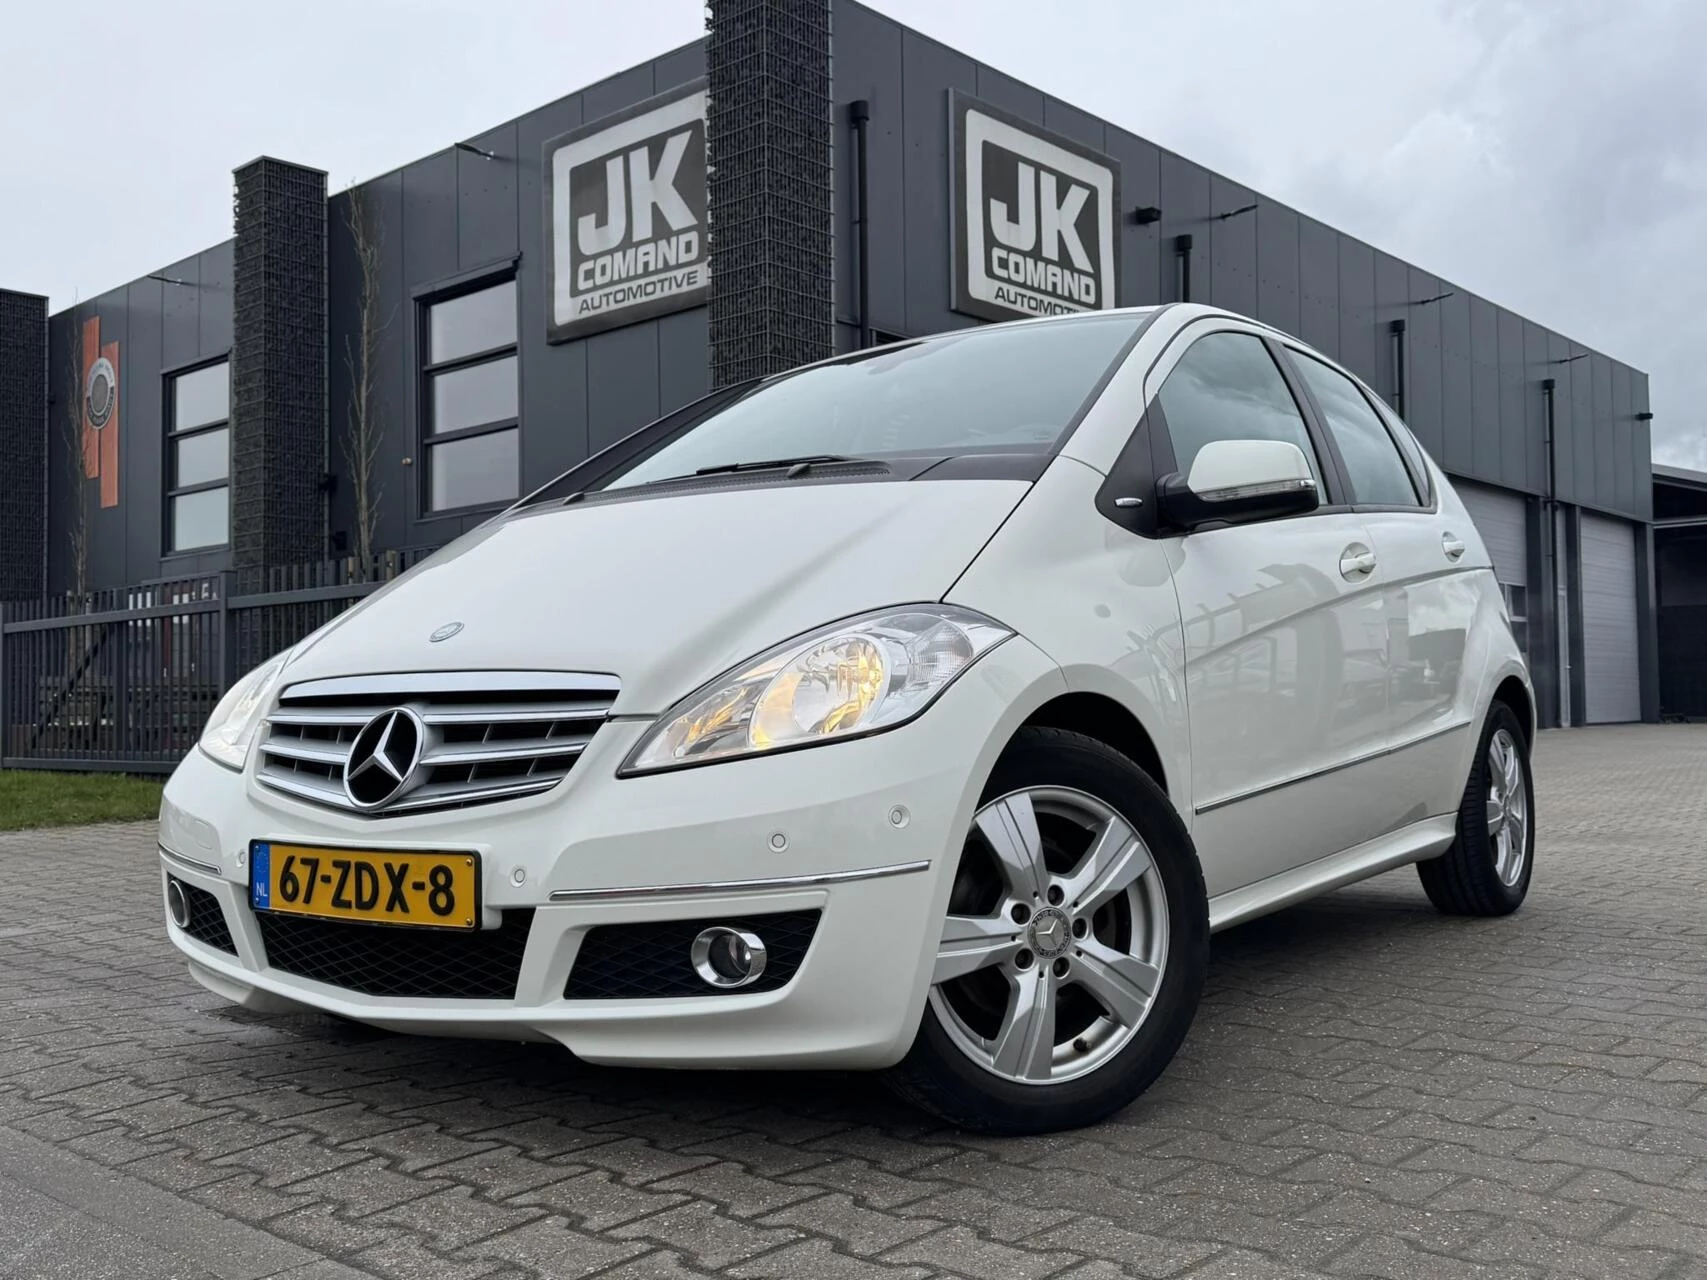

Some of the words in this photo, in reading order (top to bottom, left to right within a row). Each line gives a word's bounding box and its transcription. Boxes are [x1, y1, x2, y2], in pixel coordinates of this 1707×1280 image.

[578, 130, 698, 256] JK
[990, 161, 1094, 273] JK
[577, 231, 699, 291] COMAND
[992, 247, 1096, 305] COMAND
[578, 270, 699, 314] AUTOMOTIVE
[256, 882, 268, 897] NL
[279, 855, 455, 916] 67-ZDX-8
